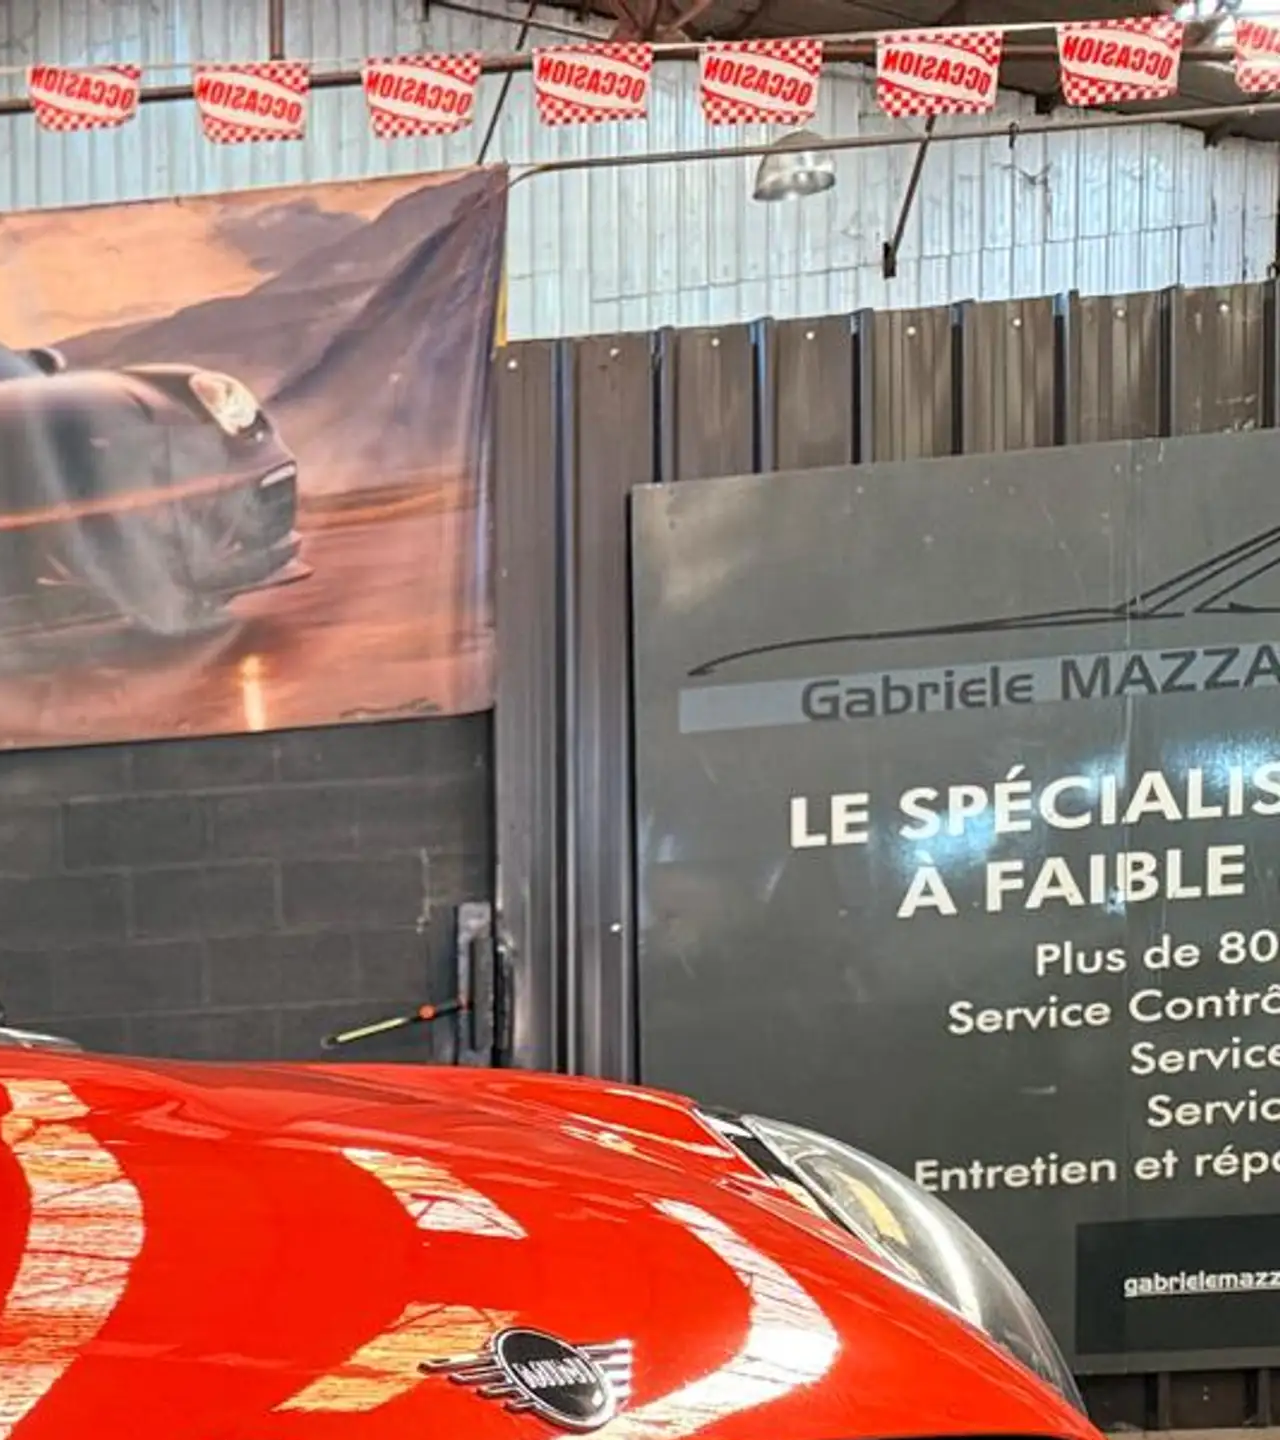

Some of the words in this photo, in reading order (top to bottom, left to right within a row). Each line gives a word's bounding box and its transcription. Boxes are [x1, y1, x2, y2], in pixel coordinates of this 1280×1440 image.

[800, 665, 1035, 722] Gabriele
[1060, 644, 1280, 702] MAZZA
[789, 792, 870, 850] LE
[897, 760, 1280, 841] SPÉCIALIS
[896, 849, 958, 919] À
[985, 844, 1247, 913] FAIBLE
[1035, 940, 1127, 977] Plus
[1142, 934, 1201, 970] de
[1218, 929, 1280, 965] 80
[947, 994, 1111, 1035] Service
[1128, 983, 1280, 1023] Contrô
[913, 1152, 1117, 1193] Entretien
[1134, 1148, 1179, 1181] et
[1194, 1144, 1280, 1183] rép
[511, 1356, 598, 1390] MINI
